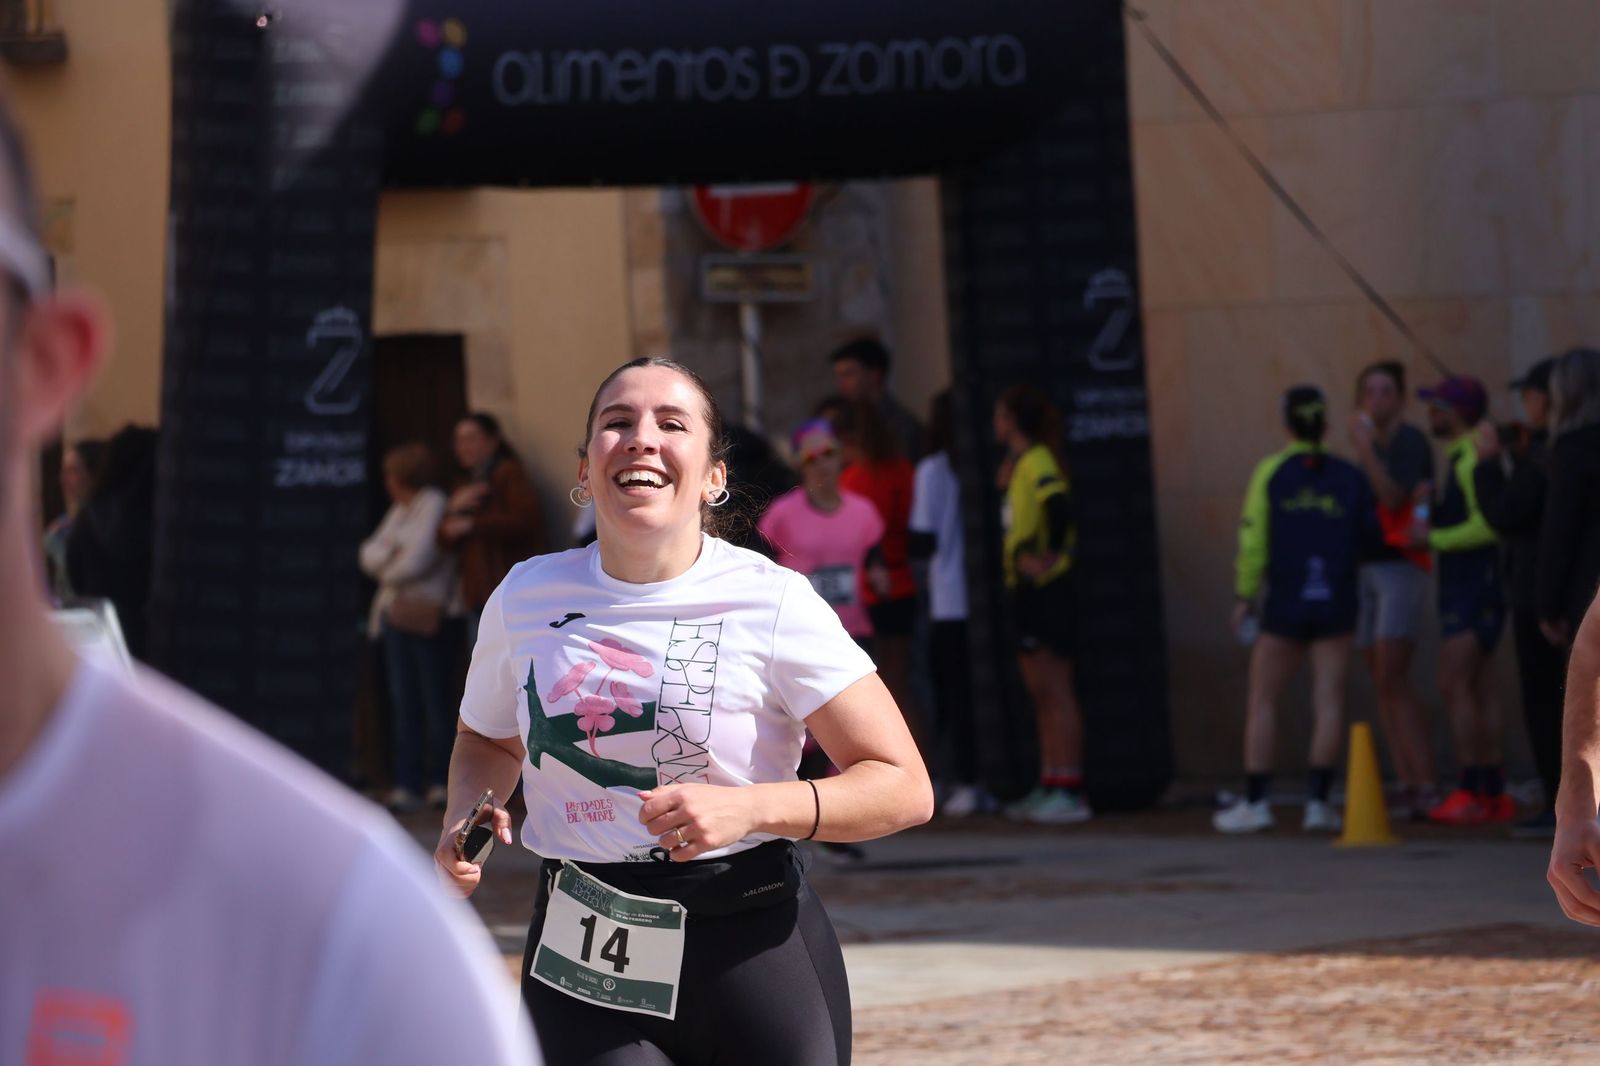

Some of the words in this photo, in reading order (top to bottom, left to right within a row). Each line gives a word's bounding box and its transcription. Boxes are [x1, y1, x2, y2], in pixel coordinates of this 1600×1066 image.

[492, 46, 761, 106] alimentos
[817, 35, 1026, 94] zamora
[273, 459, 365, 487] ZAMOR
[742, 881, 785, 898] SALOMON
[580, 914, 630, 974] 14
